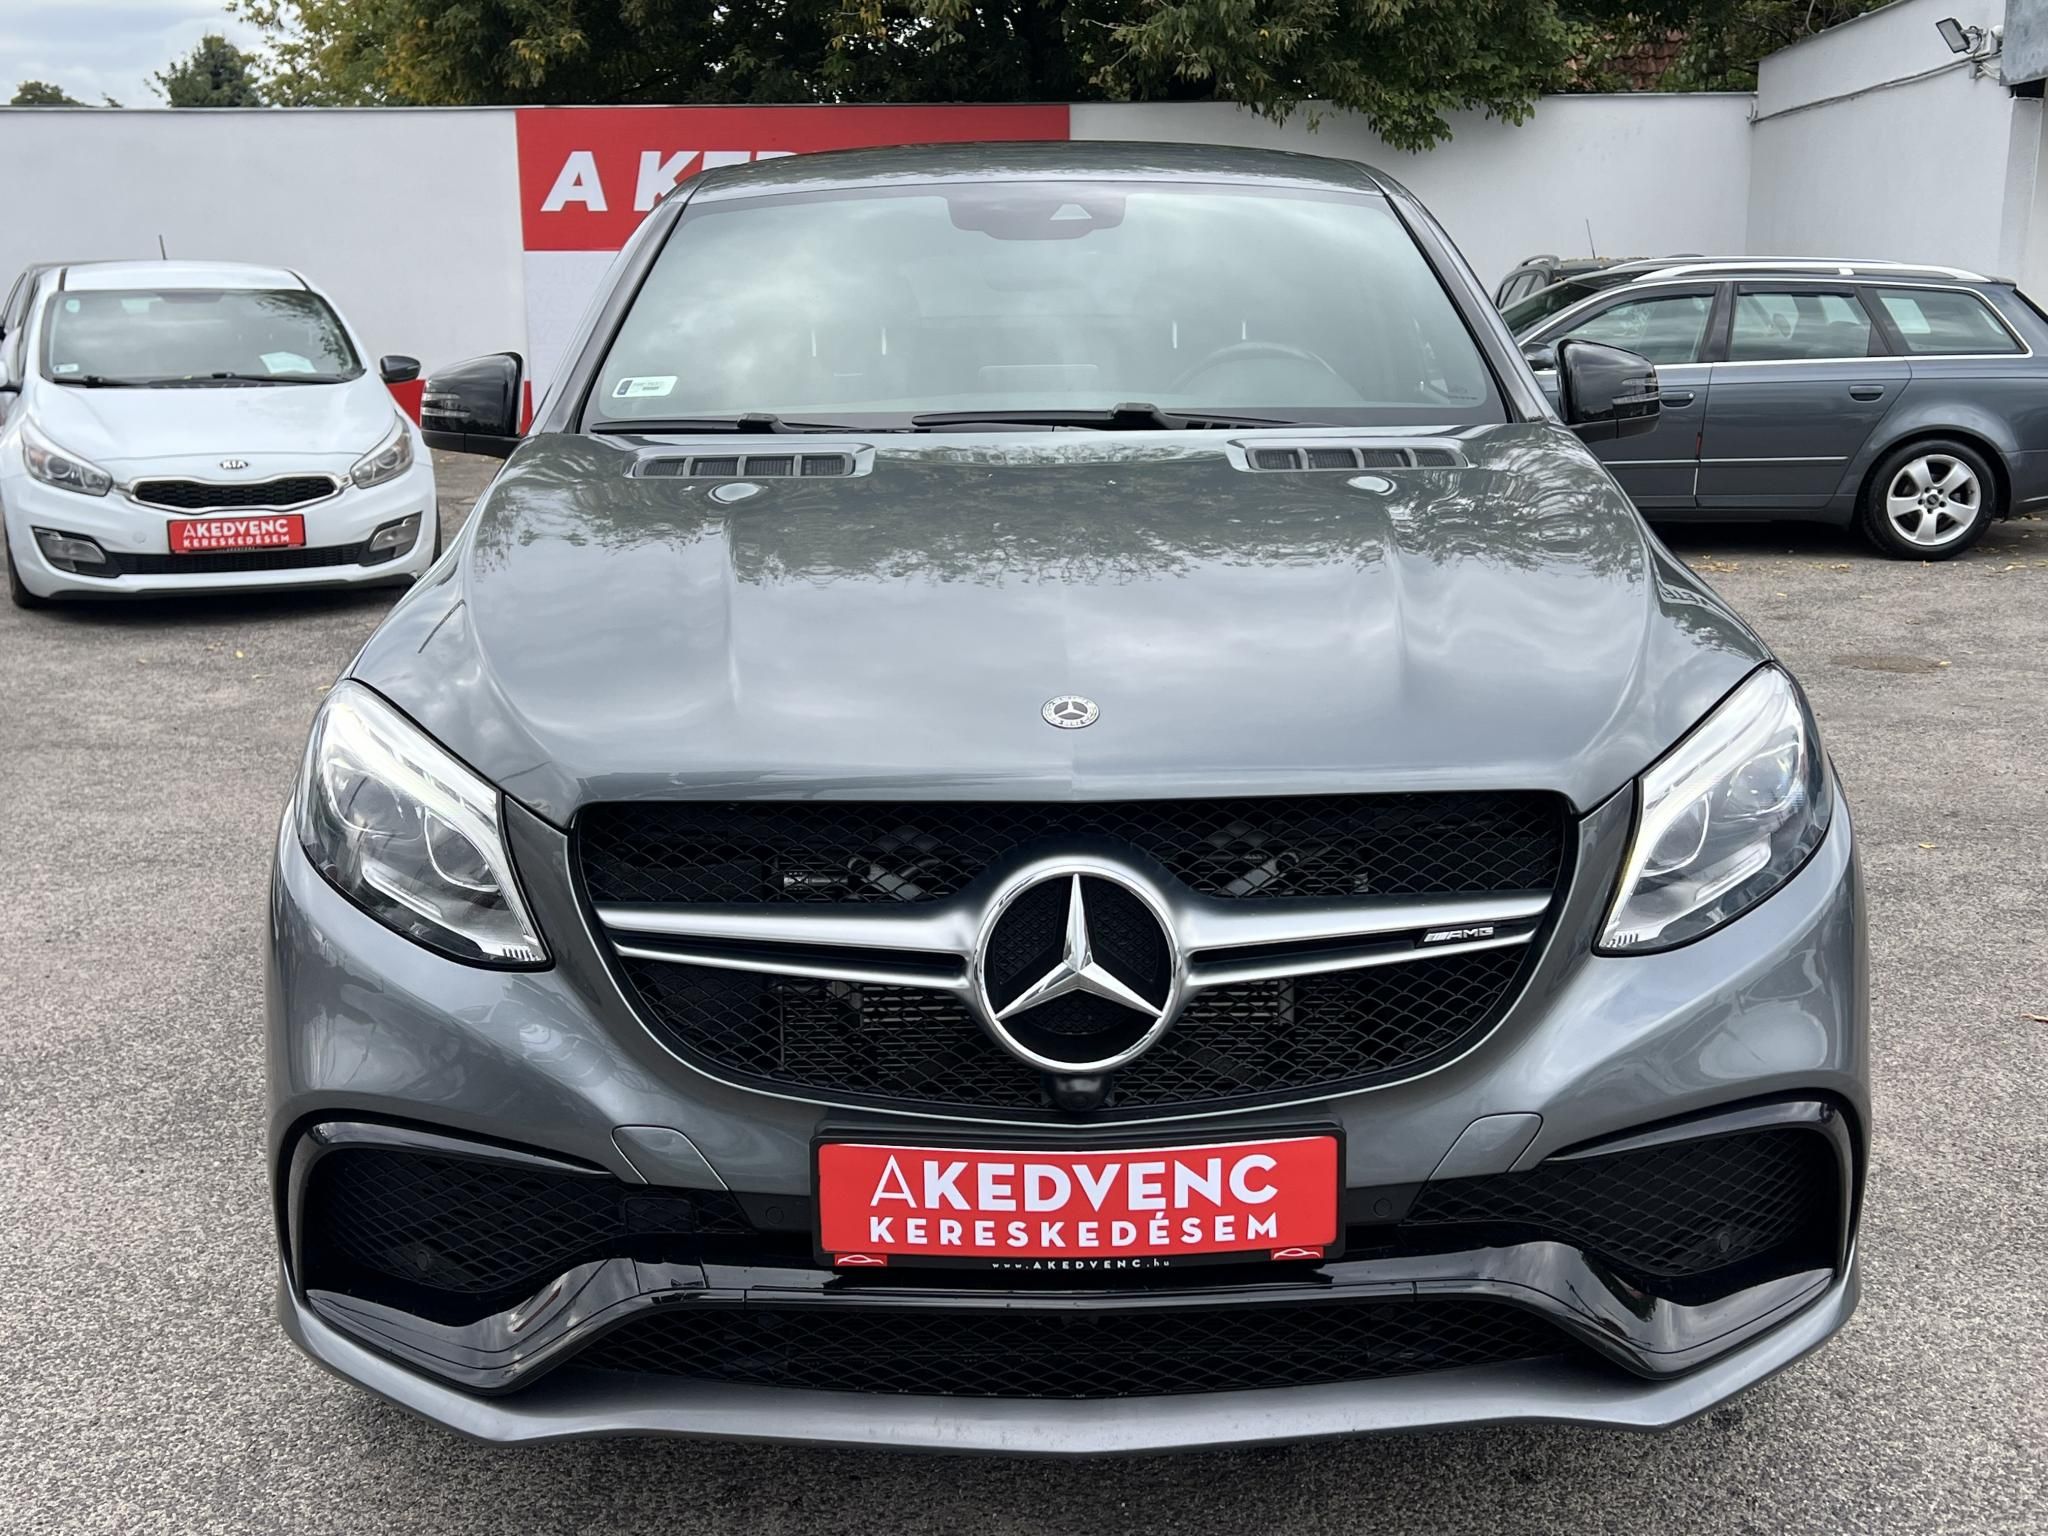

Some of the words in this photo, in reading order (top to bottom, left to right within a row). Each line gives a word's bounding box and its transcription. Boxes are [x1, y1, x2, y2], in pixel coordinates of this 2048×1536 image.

[540, 151, 608, 211] A
[222, 460, 246, 469] KIA
[183, 534, 289, 548] KERESKEDÉSEM
[1446, 926, 1494, 940] AMG
[868, 1211, 1278, 1248] KERESKEDÉSEM
